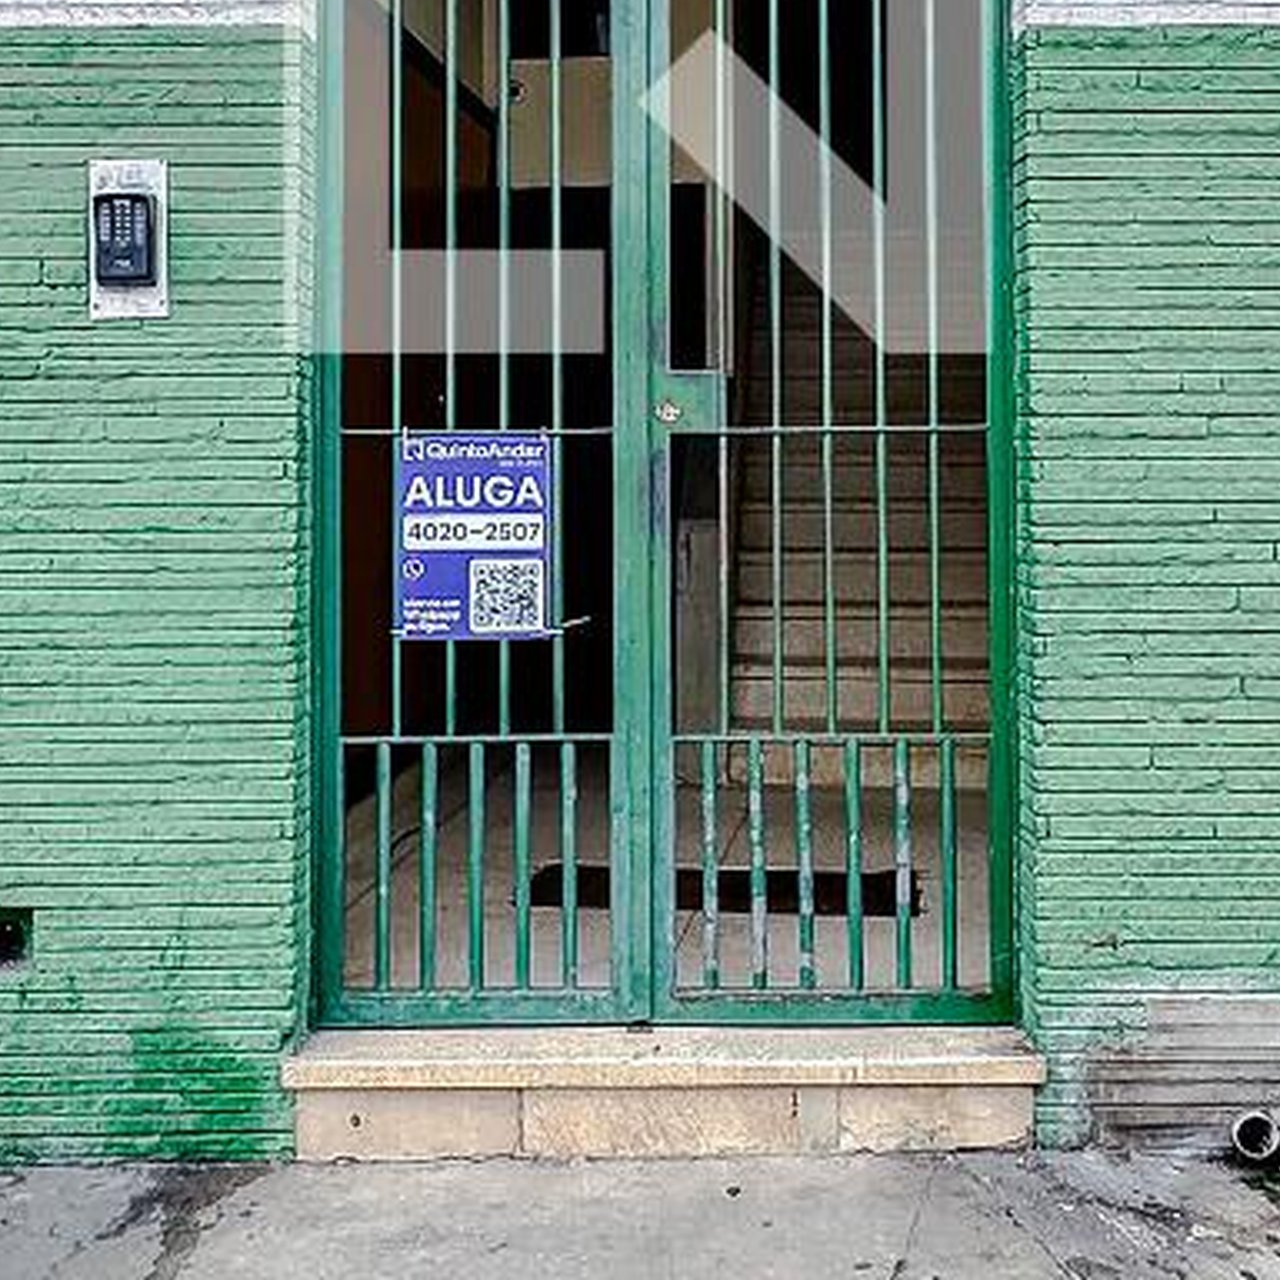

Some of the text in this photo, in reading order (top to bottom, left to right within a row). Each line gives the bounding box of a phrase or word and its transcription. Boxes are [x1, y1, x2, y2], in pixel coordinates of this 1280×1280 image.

[426, 441, 544, 460] QuintoAndar
[404, 476, 544, 508] ALUGA
[407, 523, 541, 541] 4020-2507
